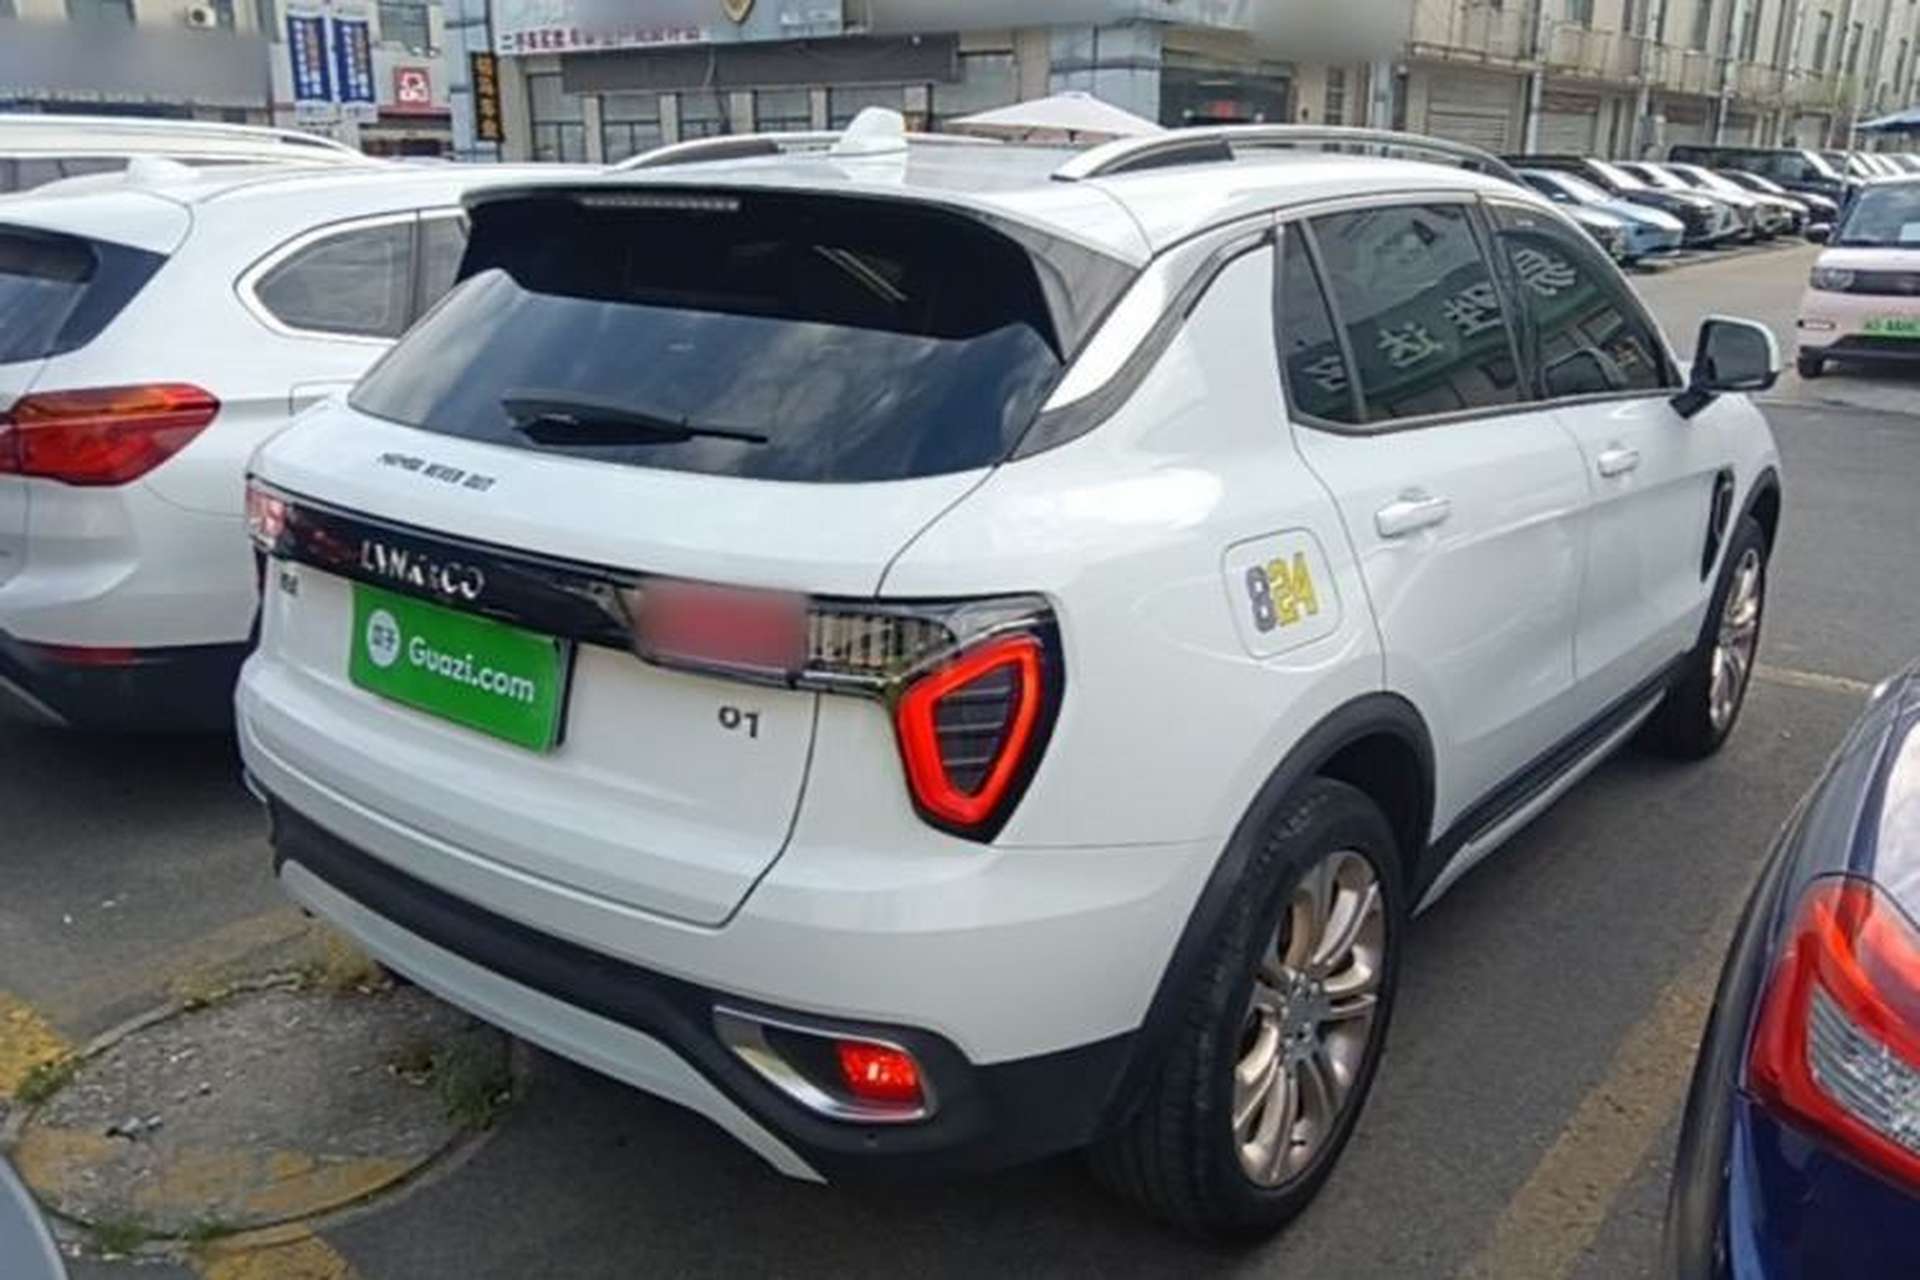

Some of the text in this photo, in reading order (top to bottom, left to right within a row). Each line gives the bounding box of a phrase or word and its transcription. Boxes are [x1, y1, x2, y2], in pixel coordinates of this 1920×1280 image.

[1245, 551, 1318, 634] 824
[408, 635, 535, 703] Guazi.com
[718, 705, 758, 739] 01
